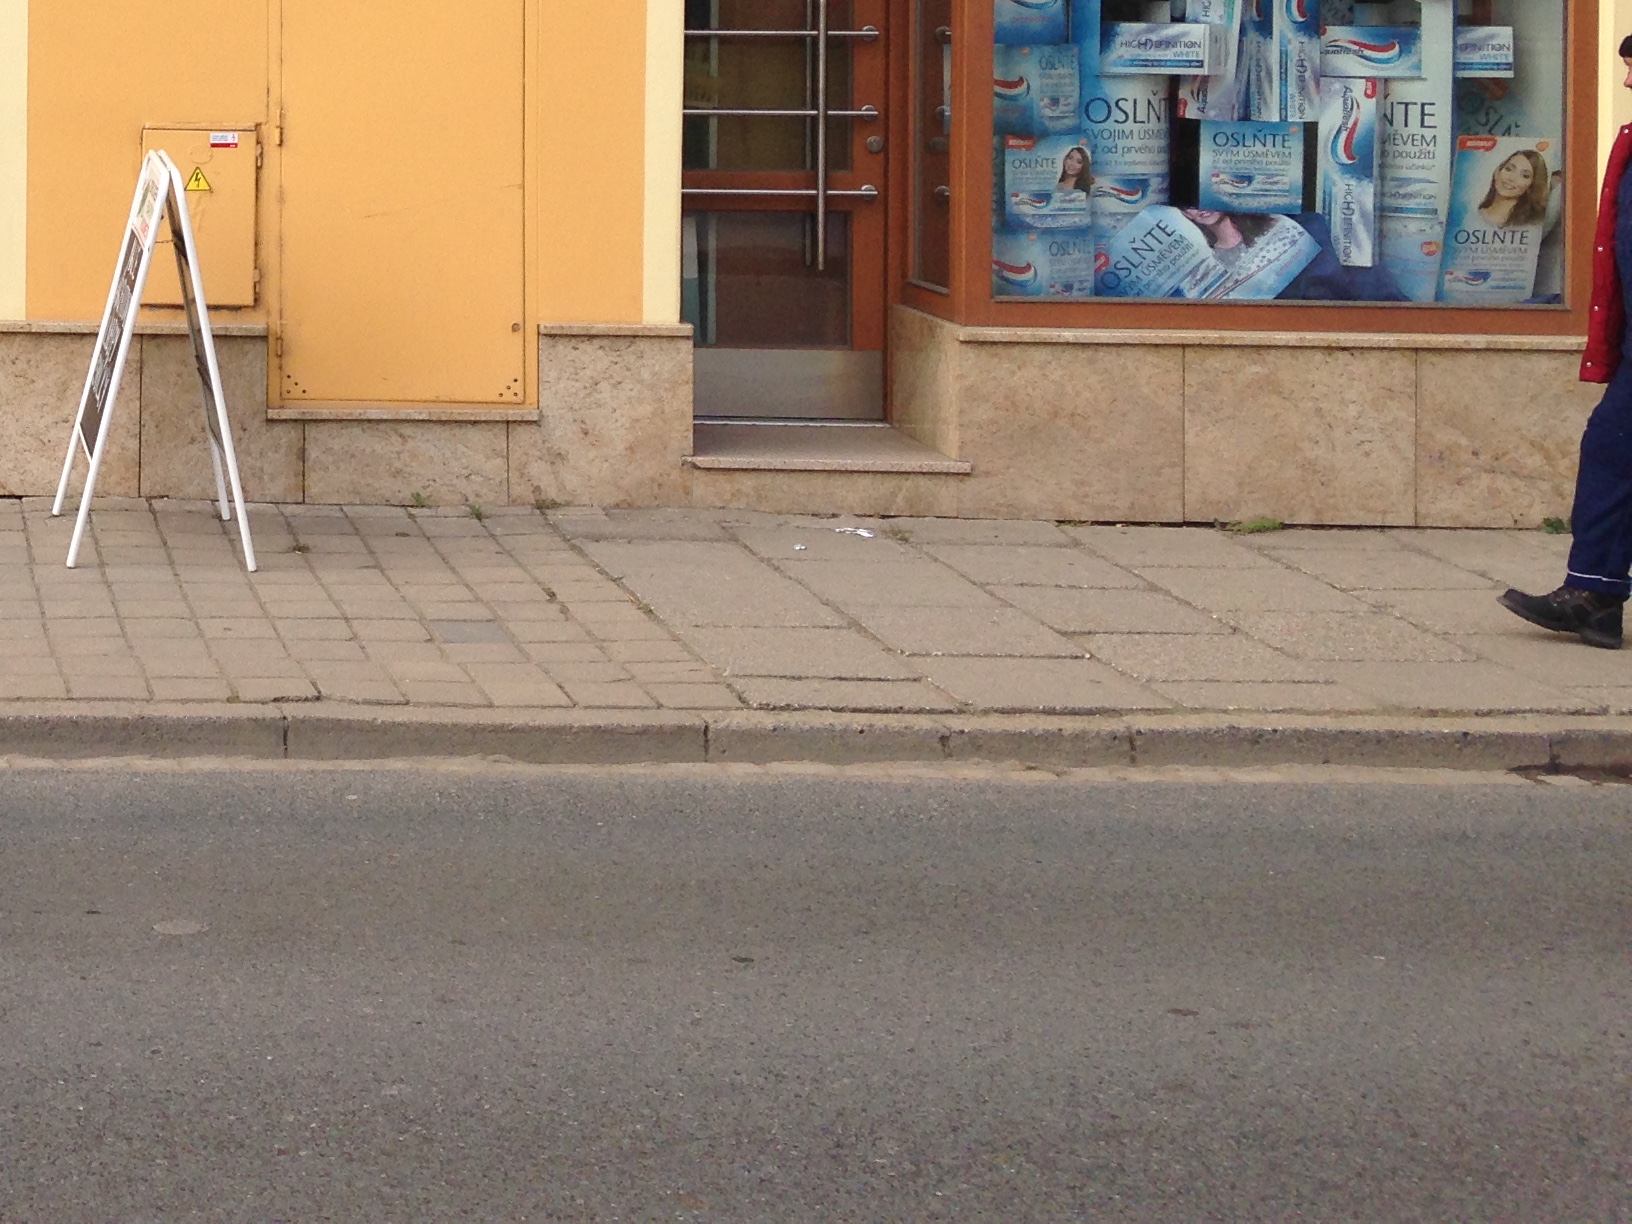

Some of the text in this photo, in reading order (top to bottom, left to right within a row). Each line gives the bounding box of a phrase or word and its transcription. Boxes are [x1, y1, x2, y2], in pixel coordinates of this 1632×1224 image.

[1084, 90, 1168, 124] OSLŇT
[1212, 128, 1292, 149] OSLŇTE
[1392, 148, 1436, 161] použití
[1101, 219, 1176, 290] OSLŇTE
